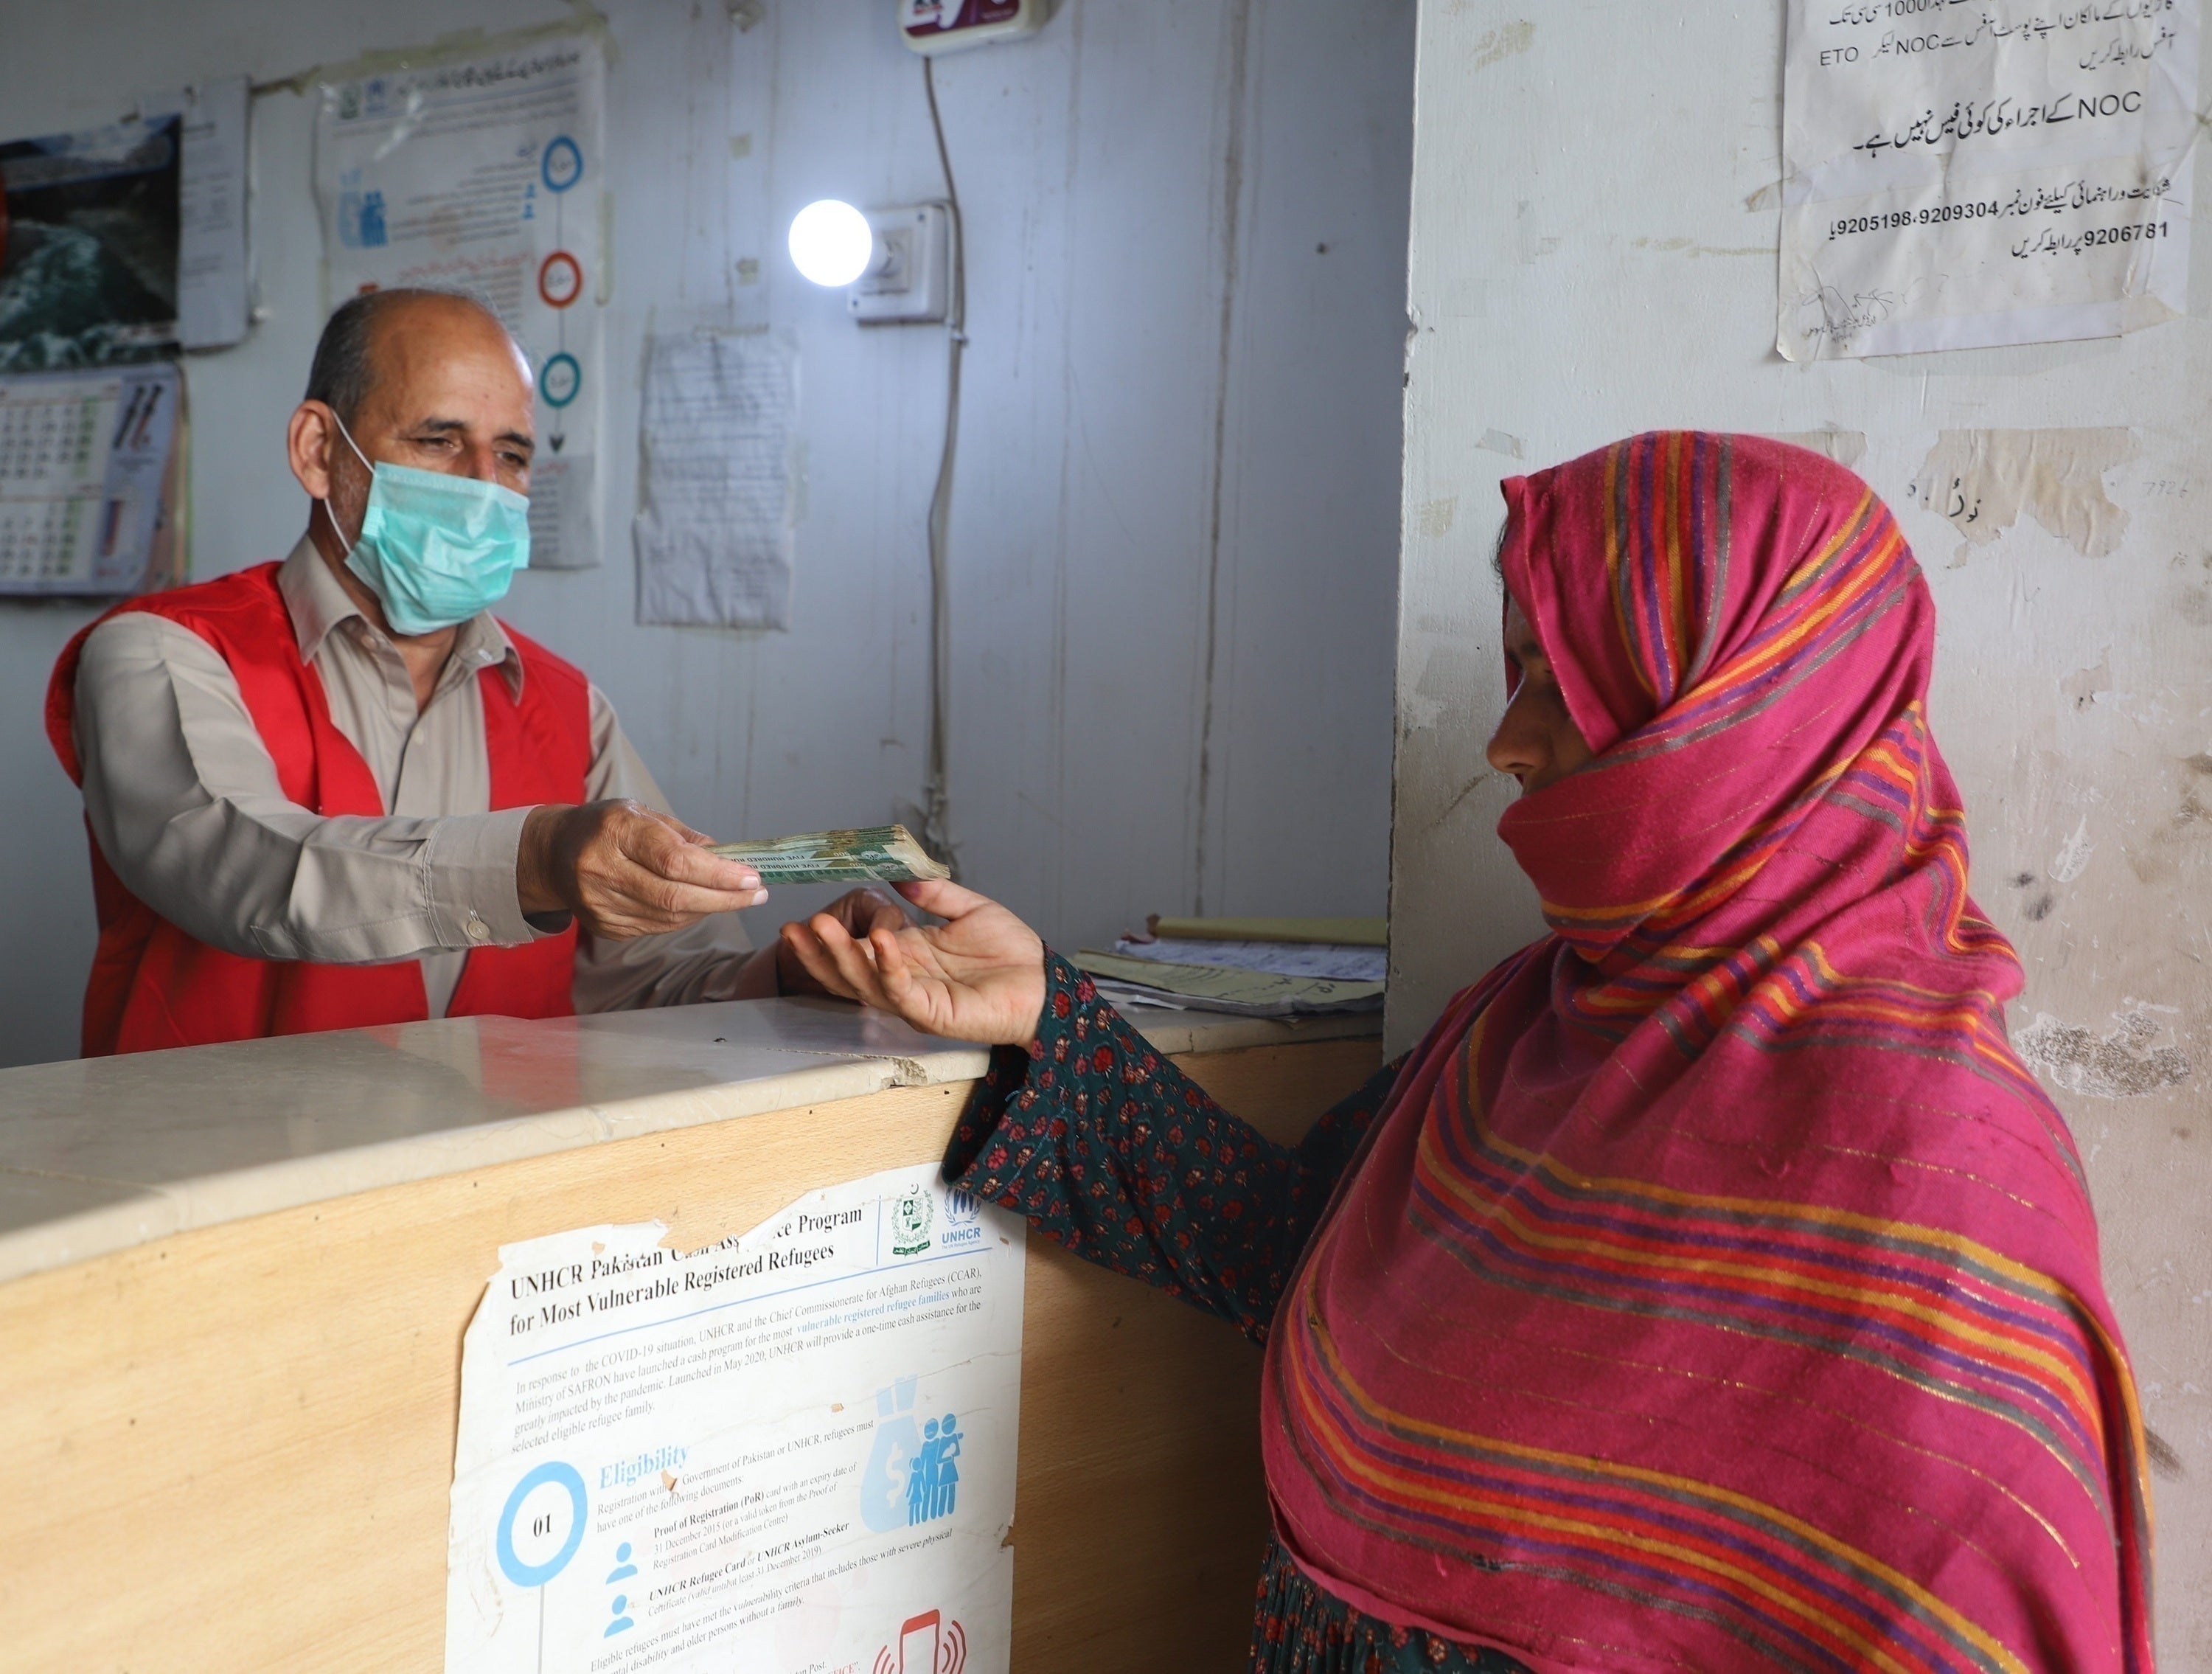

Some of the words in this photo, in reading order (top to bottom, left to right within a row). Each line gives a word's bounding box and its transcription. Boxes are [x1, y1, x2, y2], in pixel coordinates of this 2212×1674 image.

[1820, 46, 1859, 66] ETO
[1896, 34, 1939, 55] NOC
[2079, 91, 2141, 119] NOC
[2084, 221, 2168, 246] 9206781
[511, 1264, 582, 1299] UNHCR
[591, 1249, 663, 1279] Pakistan
[799, 1209, 862, 1233] Program
[942, 1227, 981, 1243] UNHCR
[510, 1315, 534, 1335] for
[540, 1299, 582, 1327] Most
[588, 1277, 679, 1313] Vulnerable
[684, 1252, 763, 1292] Registered
[769, 1244, 835, 1271] Refugees
[515, 1395, 553, 1414] Ministry
[568, 1375, 611, 1397] SAFRON
[614, 1369, 636, 1383] have
[639, 1355, 678, 1378] launched
[688, 1349, 707, 1364] cash
[709, 1341, 743, 1361] program
[773, 1326, 793, 1341] most
[797, 1313, 842, 1333] vulnerable
[844, 1303, 885, 1324] registered
[887, 1296, 917, 1313] refugee
[918, 1291, 950, 1306] families
[951, 1285, 968, 1299] who
[970, 1285, 981, 1295] are
[516, 1382, 525, 1395] In
[529, 1370, 567, 1390] response
[602, 1344, 654, 1367] COVID-19
[700, 1322, 734, 1342] UNHCR
[770, 1309, 794, 1324] Chief
[795, 1294, 863, 1317] Commissionerate
[879, 1284, 908, 1299] Afghan
[910, 1275, 945, 1291] Refugees
[947, 1267, 982, 1284] (CCAR),
[515, 1414, 546, 1438] greatly
[548, 1400, 588, 1423] impacted
[620, 1380, 666, 1403] pandemic.
[669, 1364, 712, 1387] Launched
[724, 1357, 742, 1372] May
[744, 1350, 767, 1366] 2020,
[769, 1340, 804, 1359] UNHCR
[807, 1336, 821, 1349] will
[824, 1327, 854, 1347] provide
[862, 1317, 896, 1335] one-time
[897, 1312, 914, 1327] cash
[917, 1307, 954, 1322] assistance
[511, 1431, 549, 1454] selected
[552, 1419, 585, 1442] eligible
[588, 1409, 622, 1429] refugee
[625, 1400, 655, 1419] family.
[597, 1491, 647, 1515] Registration
[682, 1465, 730, 1485] Government
[742, 1448, 775, 1466] Pakistan
[787, 1434, 822, 1452] UNHCR,
[824, 1425, 855, 1441] refugees
[856, 1420, 874, 1432] must
[599, 1445, 690, 1490] Eligibility
[533, 1513, 551, 1538] 01
[597, 1518, 616, 1533] have
[619, 1511, 633, 1524] one
[660, 1489, 698, 1510] following
[700, 1476, 744, 1496] documents:
[654, 1518, 678, 1538] Proof
[689, 1500, 738, 1525] Registration
[741, 1490, 765, 1509] (PoR)
[766, 1485, 782, 1498] card
[783, 1481, 799, 1492] with
[810, 1470, 831, 1485] expiry
[833, 1468, 847, 1478] date
[665, 1532, 700, 1552] December
[703, 1524, 720, 1538] 2015
[740, 1508, 757, 1522] valid
[759, 1502, 777, 1515] token
[779, 1497, 798, 1510] from
[809, 1485, 829, 1498] Proof
[649, 1580, 686, 1602] UNHCR
[689, 1567, 723, 1588] Refugee
[725, 1557, 746, 1574] Card
[757, 1542, 790, 1563] UNHCR
[792, 1522, 849, 1550] Asylum-Seeker
[653, 1548, 698, 1570] Registration
[700, 1538, 717, 1554] Card
[718, 1524, 762, 1545] Modification
[763, 1512, 788, 1530] Centre)
[591, 1650, 623, 1673] Eligible
[626, 1637, 658, 1657] refugees
[661, 1628, 681, 1642] must
[683, 1619, 700, 1633] have
[703, 1612, 717, 1624] met
[734, 1588, 782, 1611] vulnerability
[785, 1578, 810, 1594] criteria
[811, 1571, 825, 1584] that
[827, 1560, 857, 1578] includes
[859, 1554, 878, 1567] those
[880, 1545, 897, 1559] with
[898, 1541, 921, 1555] severe
[922, 1528, 953, 1548] physical
[647, 1596, 686, 1617] Certificate
[688, 1584, 710, 1604] (valid
[739, 1571, 755, 1584] least
[766, 1554, 800, 1573] December
[801, 1544, 821, 1560] 2019)
[630, 1646, 667, 1671] disability
[686, 1633, 706, 1647] older
[709, 1619, 737, 1643] persons
[739, 1608, 769, 1626] without
